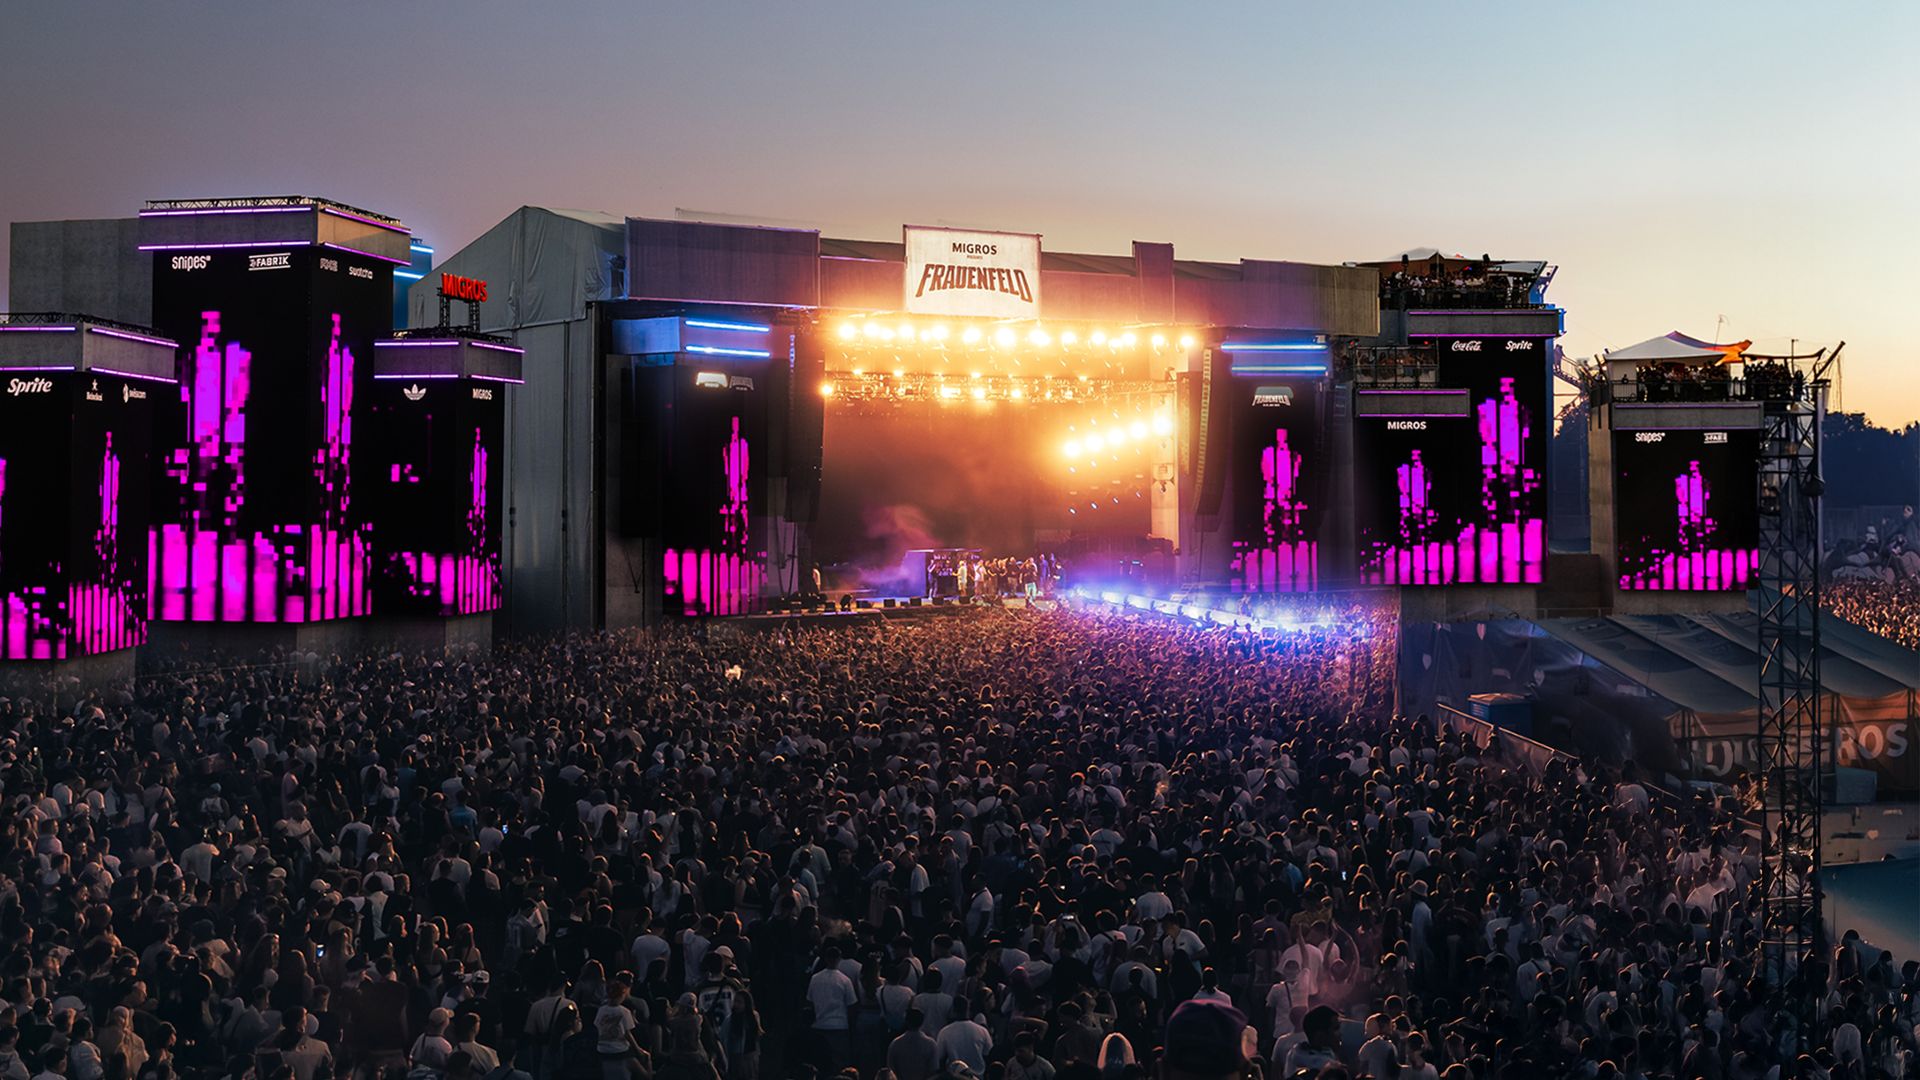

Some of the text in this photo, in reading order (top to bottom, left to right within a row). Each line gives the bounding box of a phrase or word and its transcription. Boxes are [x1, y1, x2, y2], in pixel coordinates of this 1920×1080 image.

[952, 243, 997, 255] MIGROS
[172, 255, 207, 271] snipes
[441, 273, 488, 302] MIGROS
[915, 264, 1033, 303] FRAUENFELD
[1505, 340, 1533, 352] Sprite
[7, 377, 52, 397] Sprite
[472, 388, 492, 401] MIGROS
[1387, 421, 1427, 430] MIGROS
